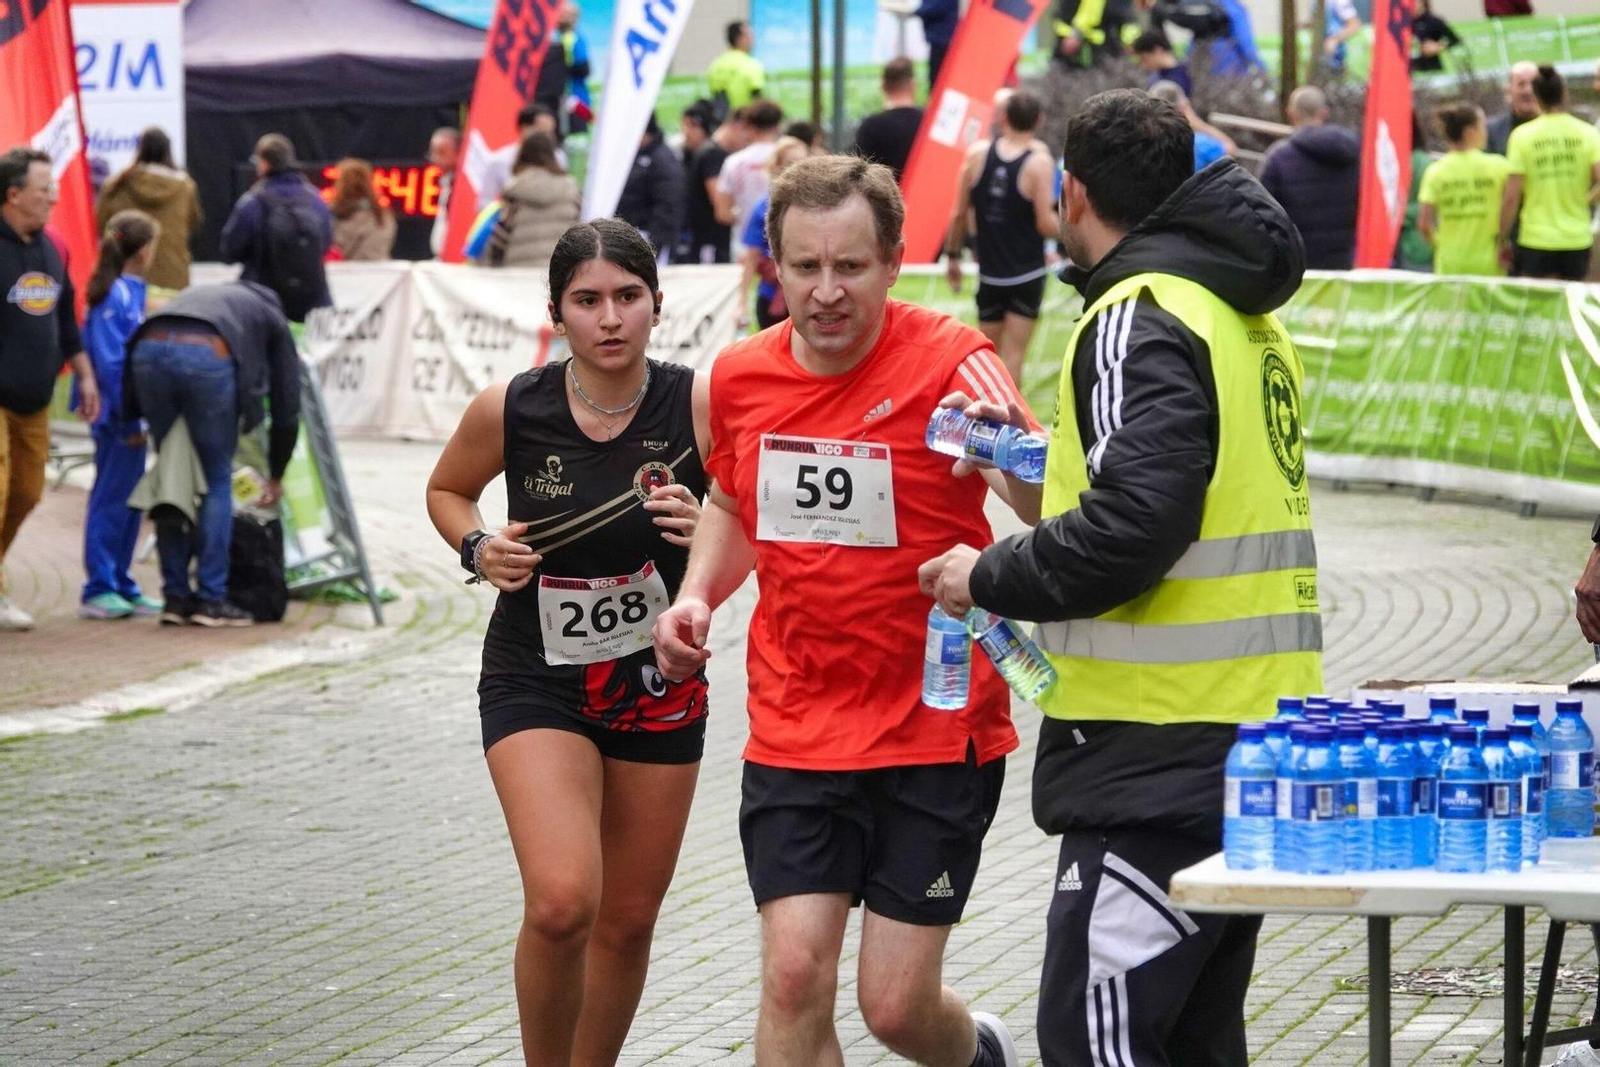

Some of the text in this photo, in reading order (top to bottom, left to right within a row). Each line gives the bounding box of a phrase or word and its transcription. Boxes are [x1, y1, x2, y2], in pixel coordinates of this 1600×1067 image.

[534, 478, 574, 499] Trigal
[796, 464, 853, 511] 59
[837, 516, 861, 524] IGLESIAS
[560, 591, 648, 637] 268
[926, 888, 954, 898] adidas
[1058, 880, 1083, 891] adidas
